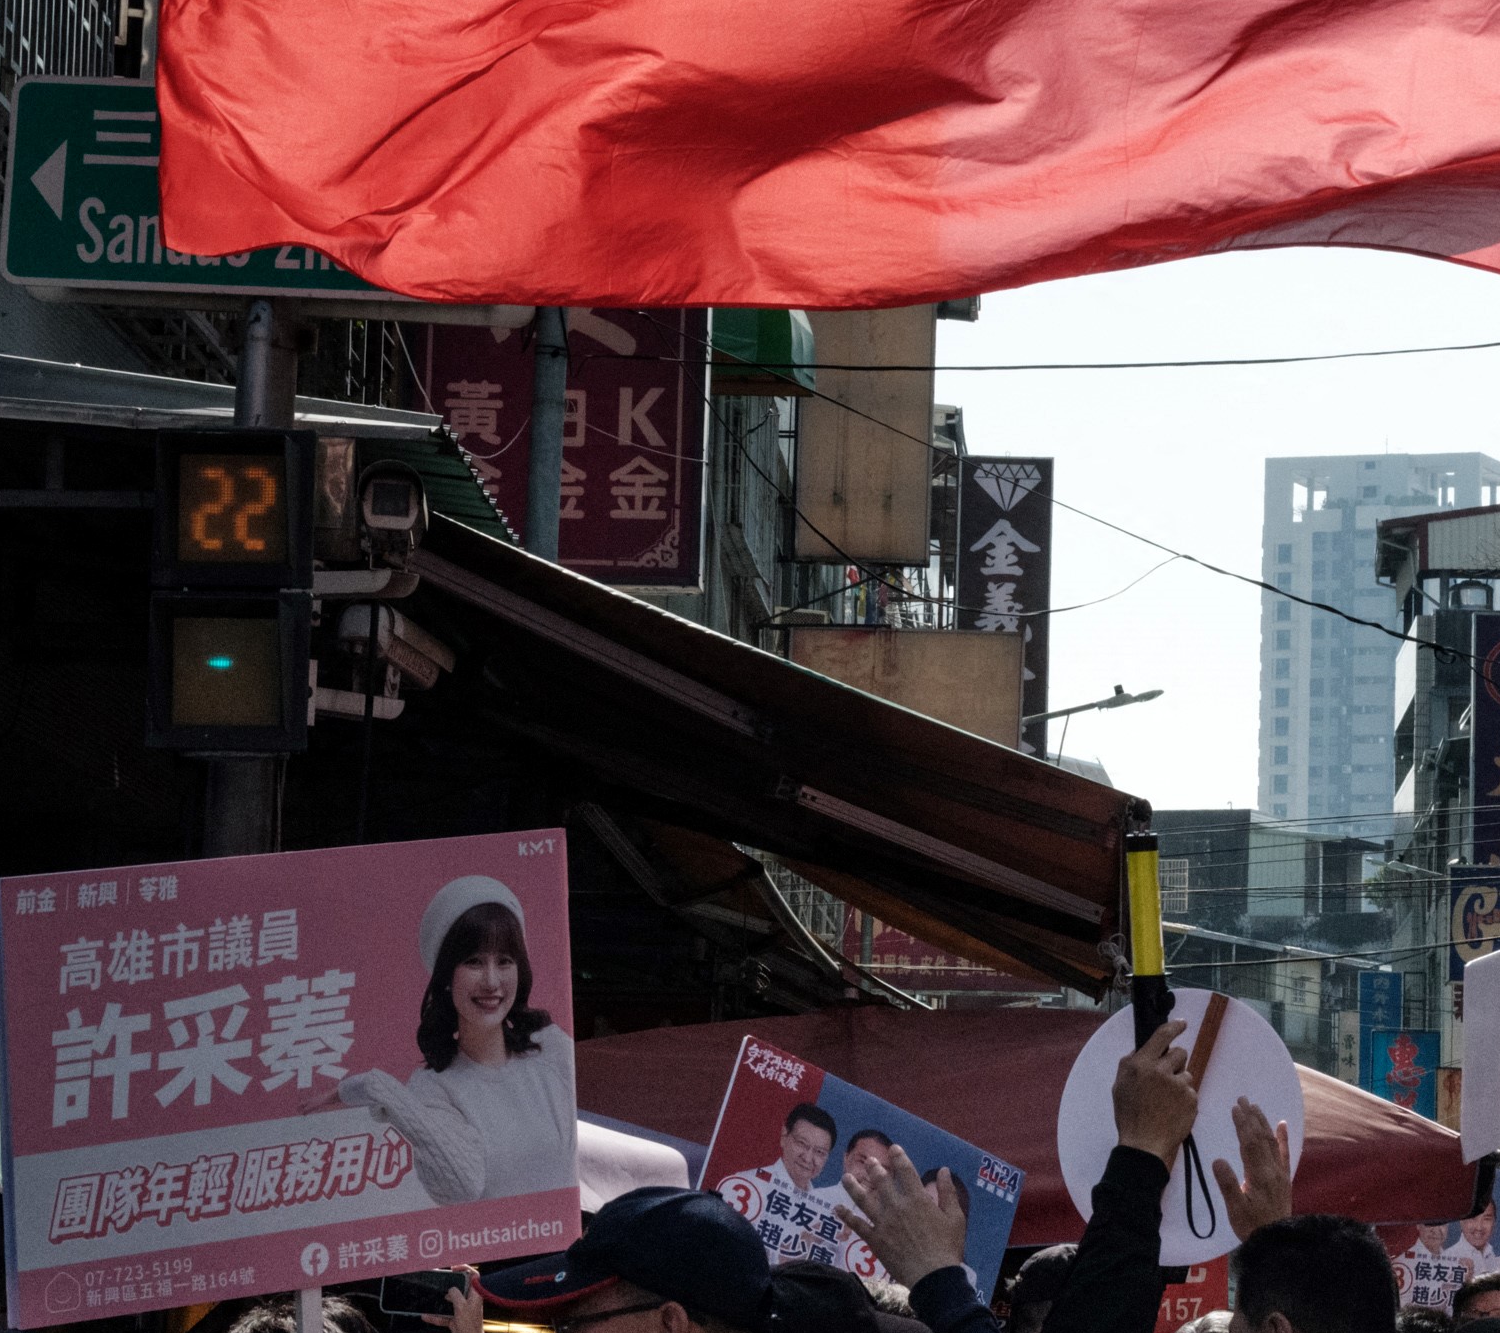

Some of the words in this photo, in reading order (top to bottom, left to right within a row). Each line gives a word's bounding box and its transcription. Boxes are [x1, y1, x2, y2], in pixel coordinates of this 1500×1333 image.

[190, 467, 277, 551] 22
[517, 837, 558, 858] KMT
[15, 887, 57, 916] 前金
[76, 880, 119, 908] 新興
[138, 874, 179, 903] 苓雅
[58, 907, 301, 995] 高雄市議員
[50, 969, 358, 1129] 許采蓁
[49, 1155, 235, 1243] 團隊年輕
[232, 1129, 413, 1216] 服務用心
[446, 1218, 564, 1252] hsutsaichen
[764, 1188, 845, 1245] 侯友宜
[84, 1257, 193, 1287] 07-723-5199
[337, 1233, 409, 1270] 許采蓁
[85, 1266, 256, 1308] 新興區五福一路164號
[1413, 1261, 1468, 1285] 侯友宜
